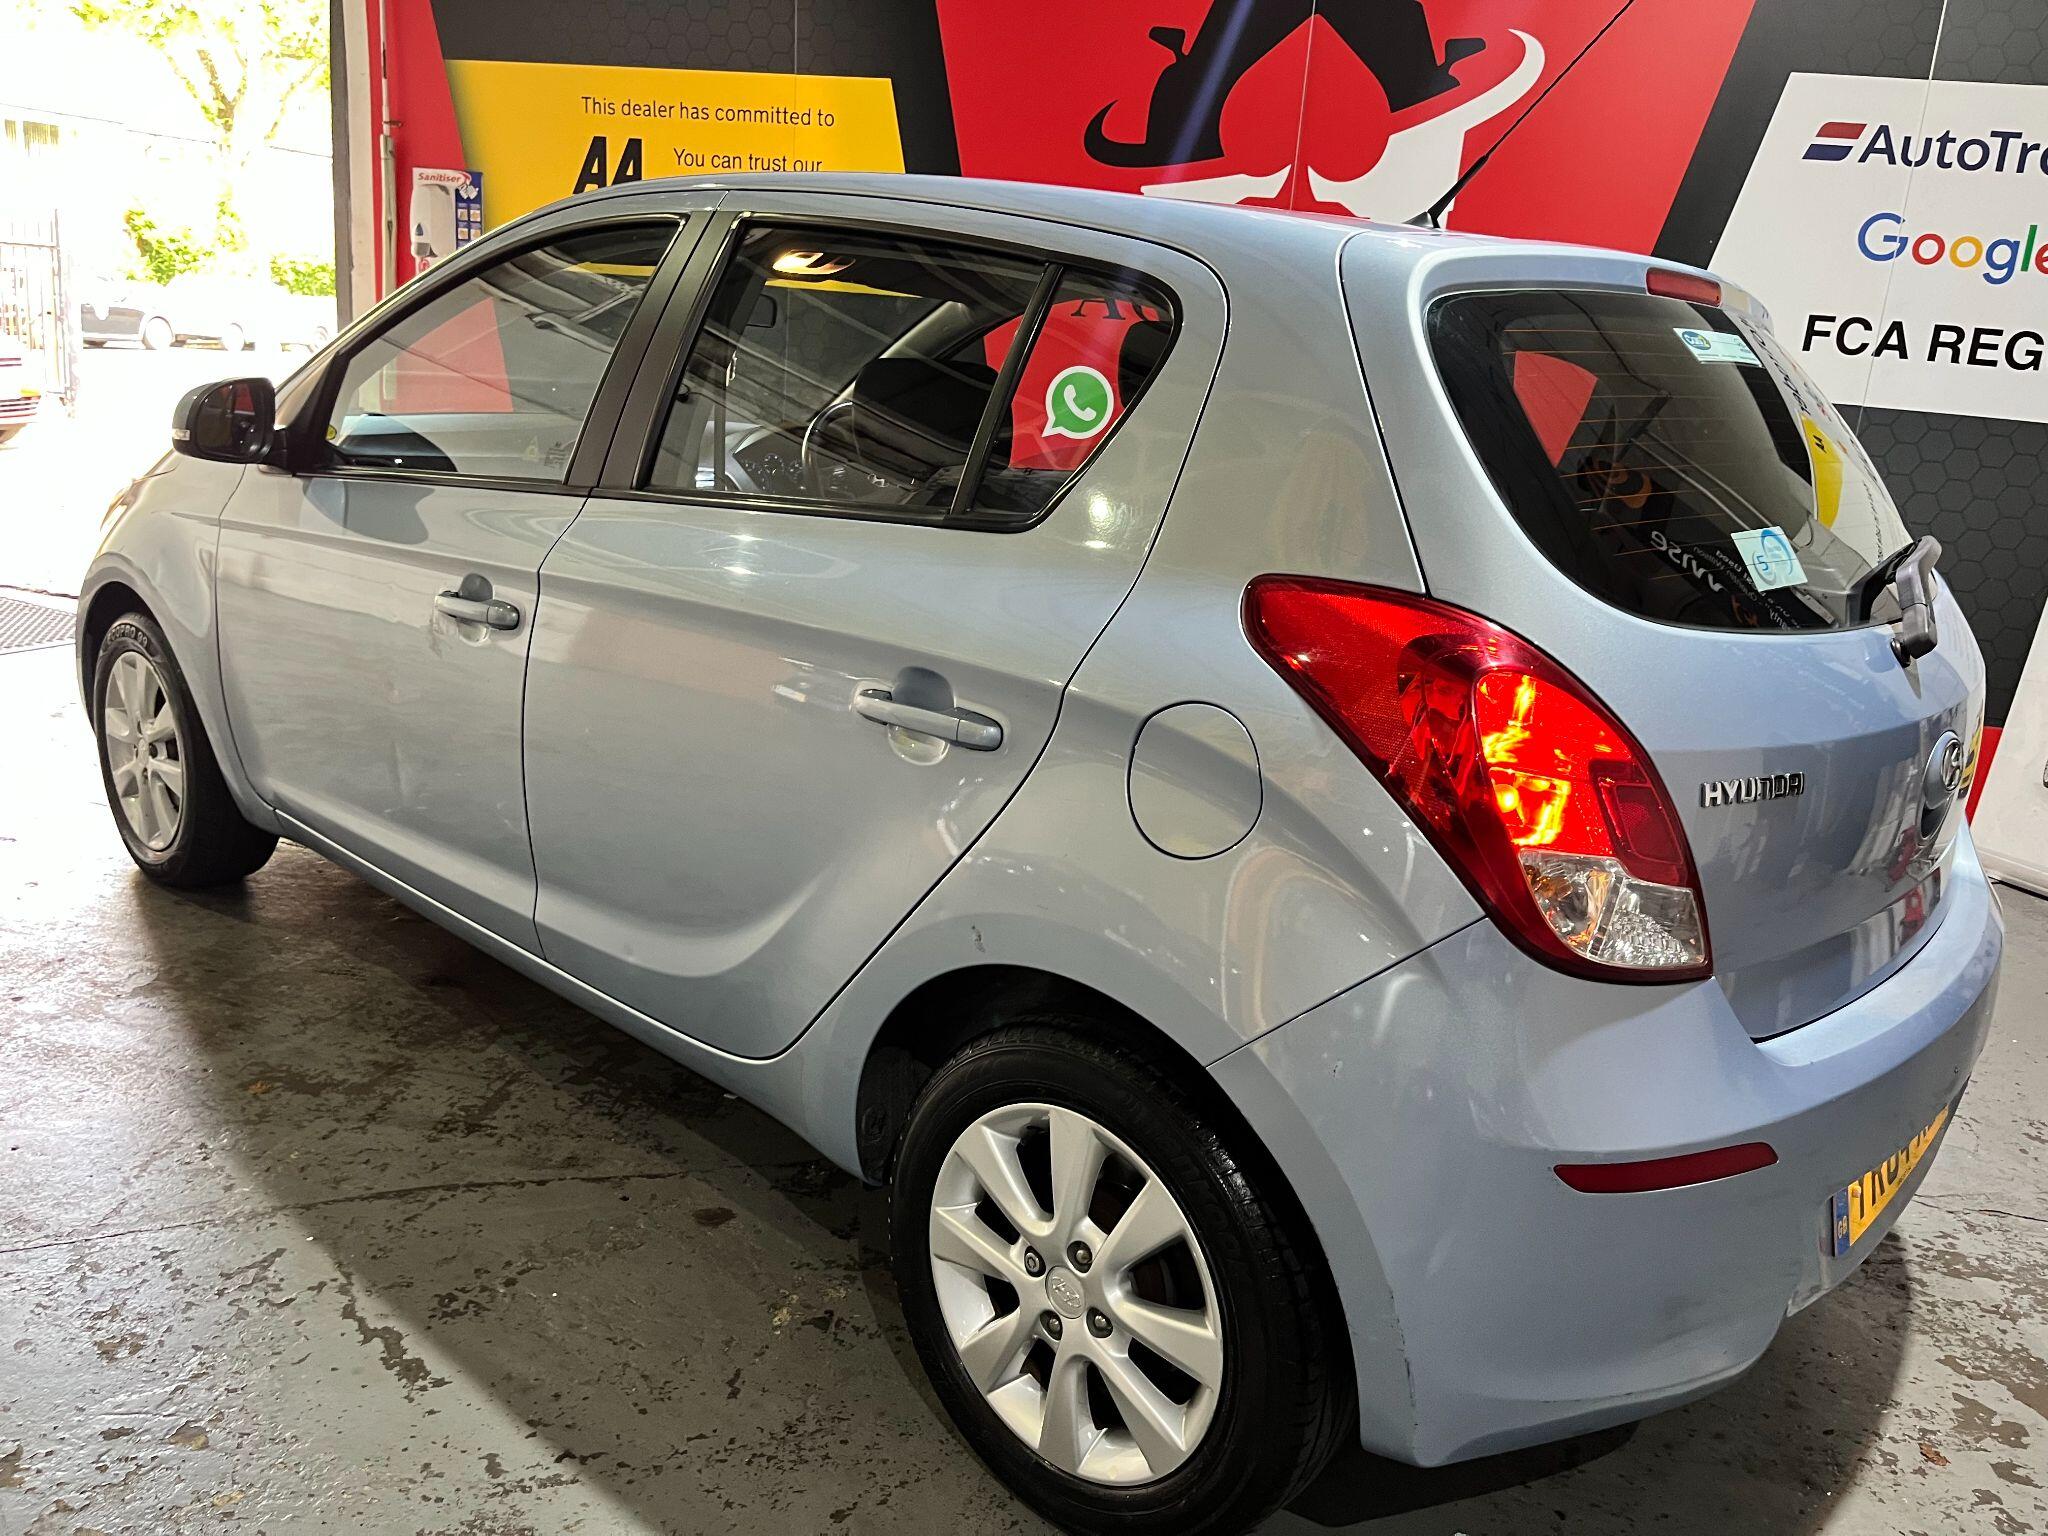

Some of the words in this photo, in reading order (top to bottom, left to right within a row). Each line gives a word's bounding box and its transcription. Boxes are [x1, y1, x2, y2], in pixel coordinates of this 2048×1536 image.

[581, 96, 616, 116] This
[621, 98, 675, 119] dealer
[679, 101, 710, 121] has
[715, 106, 811, 126] committed
[817, 108, 835, 127] to
[572, 135, 643, 195] AA
[673, 147, 705, 168] You
[711, 152, 742, 170] can
[748, 153, 787, 172] trust
[793, 159, 823, 172] our
[1857, 124, 2048, 176] AutoTr
[417, 172, 462, 184] Sanitiser
[1802, 313, 1909, 360] FCA
[1926, 323, 2045, 371] REG
[1700, 771, 1804, 808] HYUNDAI
